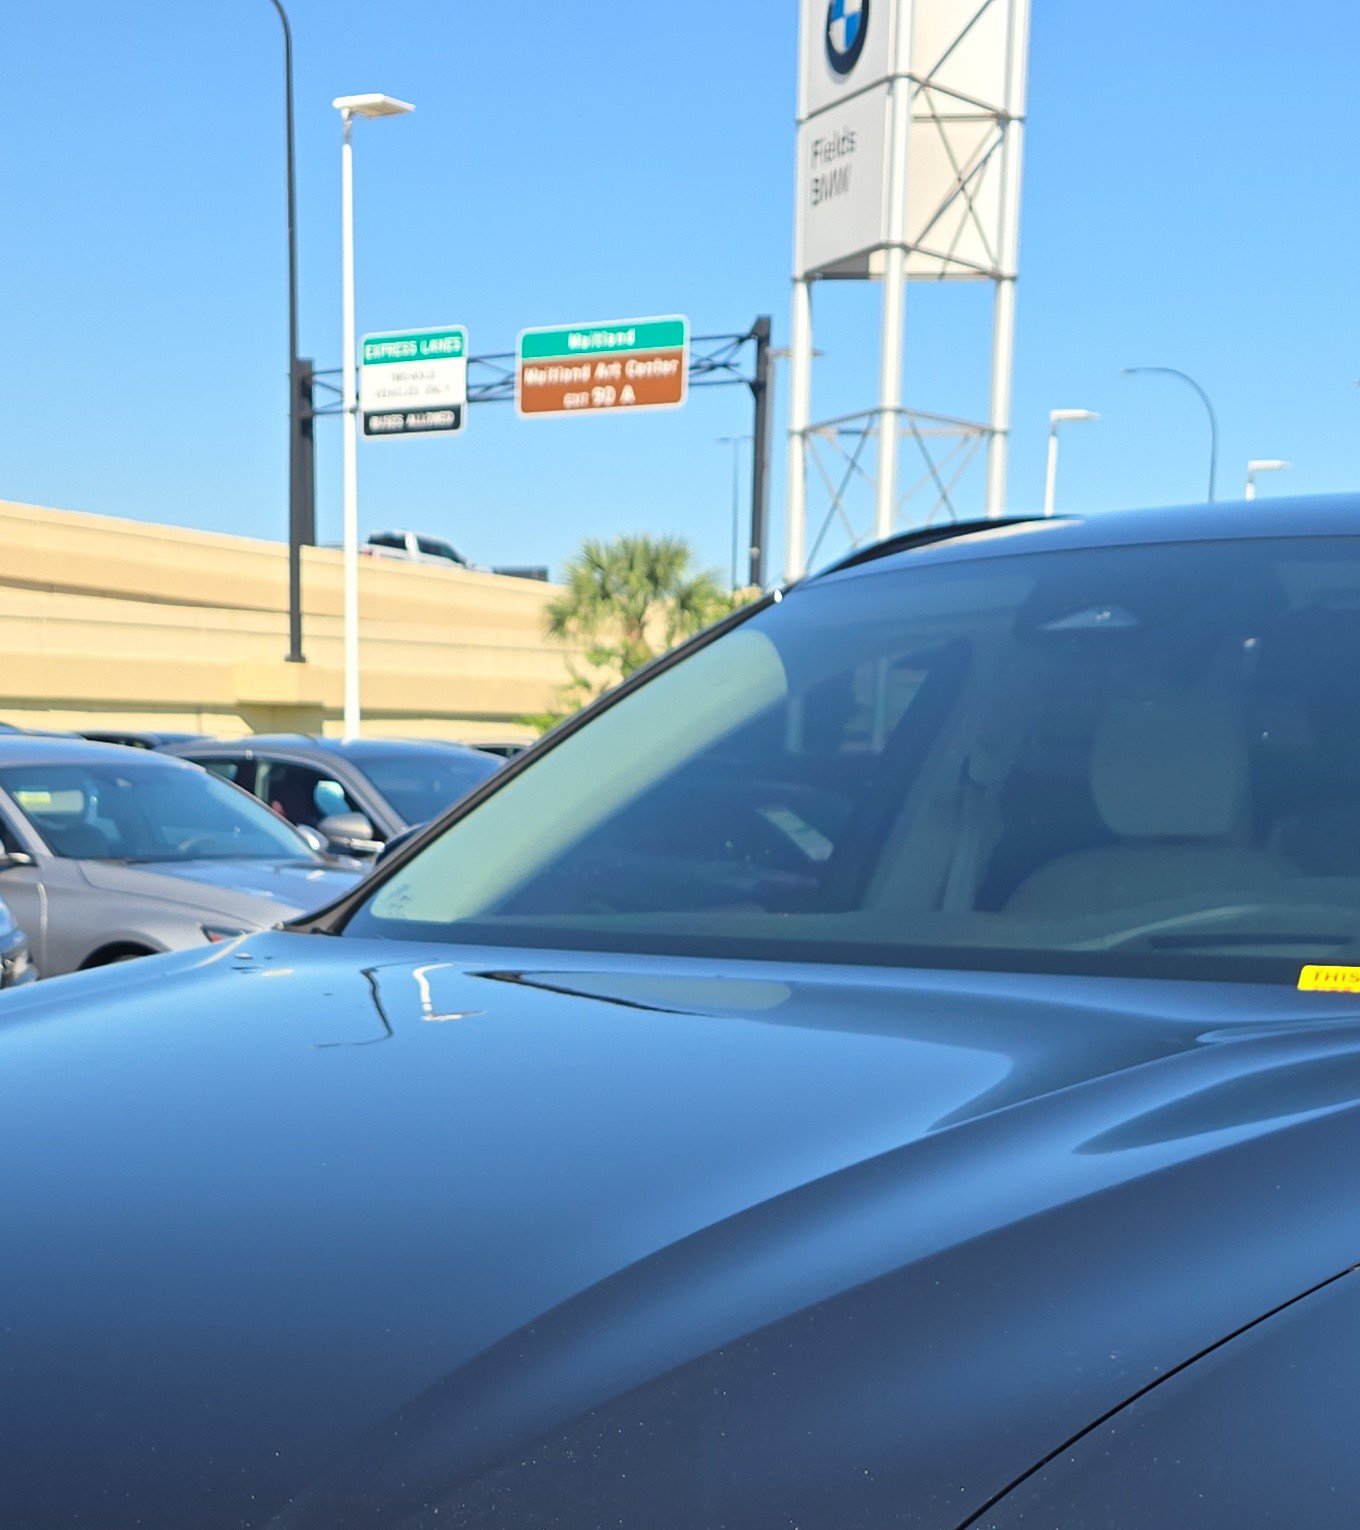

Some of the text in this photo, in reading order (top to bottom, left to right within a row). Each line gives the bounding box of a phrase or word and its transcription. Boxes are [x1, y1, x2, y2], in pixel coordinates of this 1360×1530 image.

[812, 127, 857, 163] Fields
[811, 168, 851, 206] BMW
[1313, 970, 1360, 983] THIS
